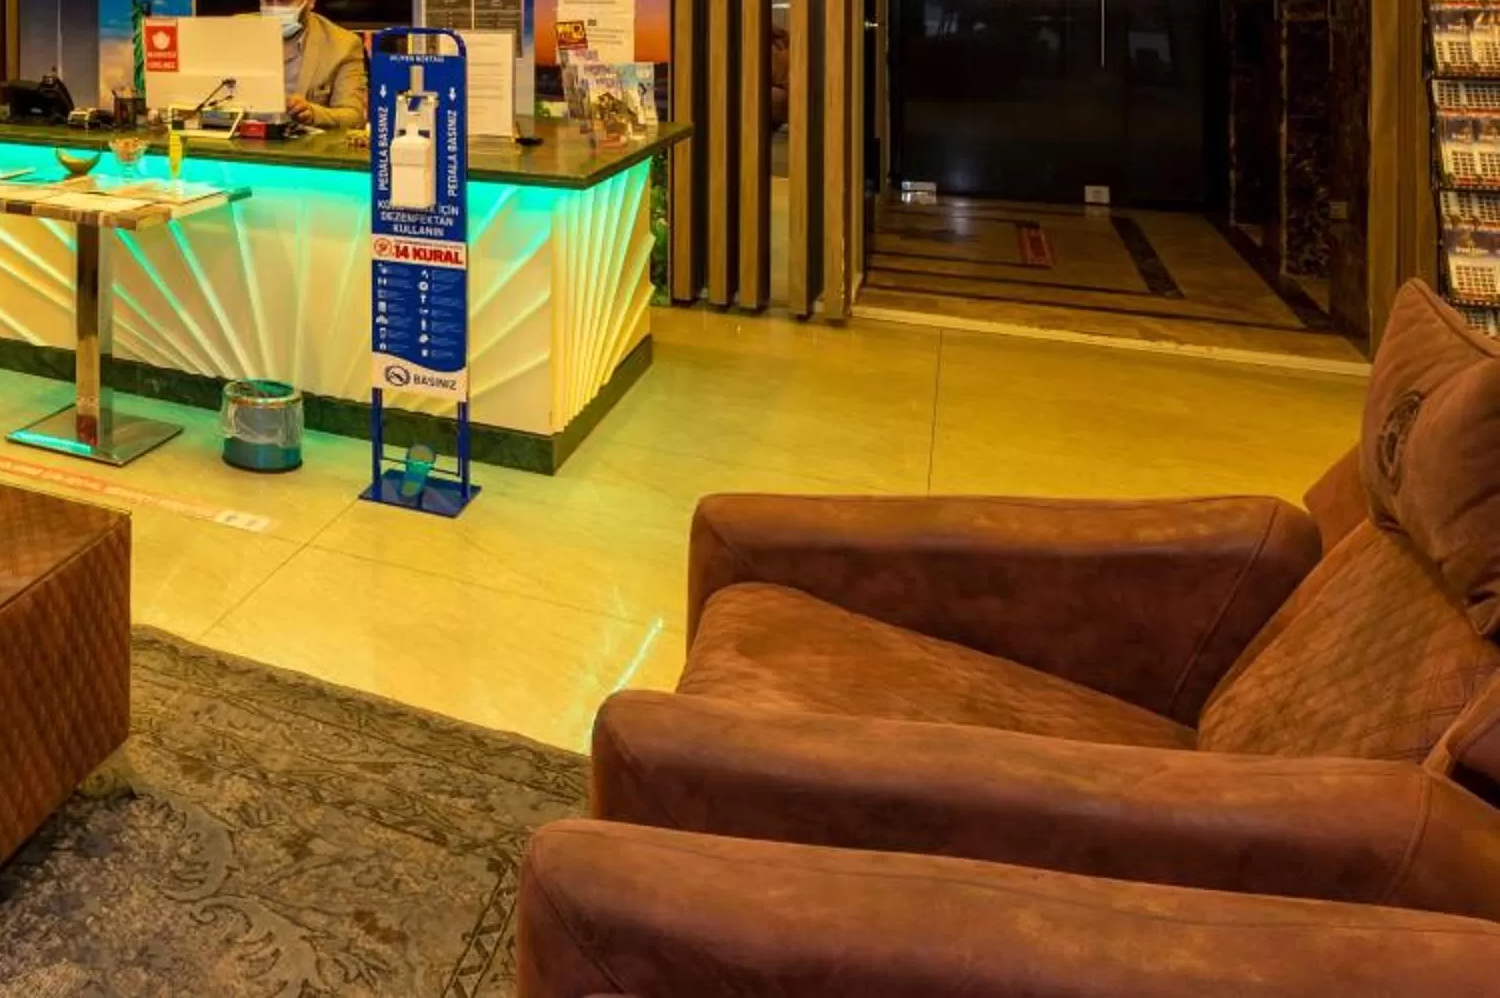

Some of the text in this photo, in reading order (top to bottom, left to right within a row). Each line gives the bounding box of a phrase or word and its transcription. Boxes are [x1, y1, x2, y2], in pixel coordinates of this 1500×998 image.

[447, 154, 457, 197] PEDALA
[394, 245, 463, 264] 14 KURAL
